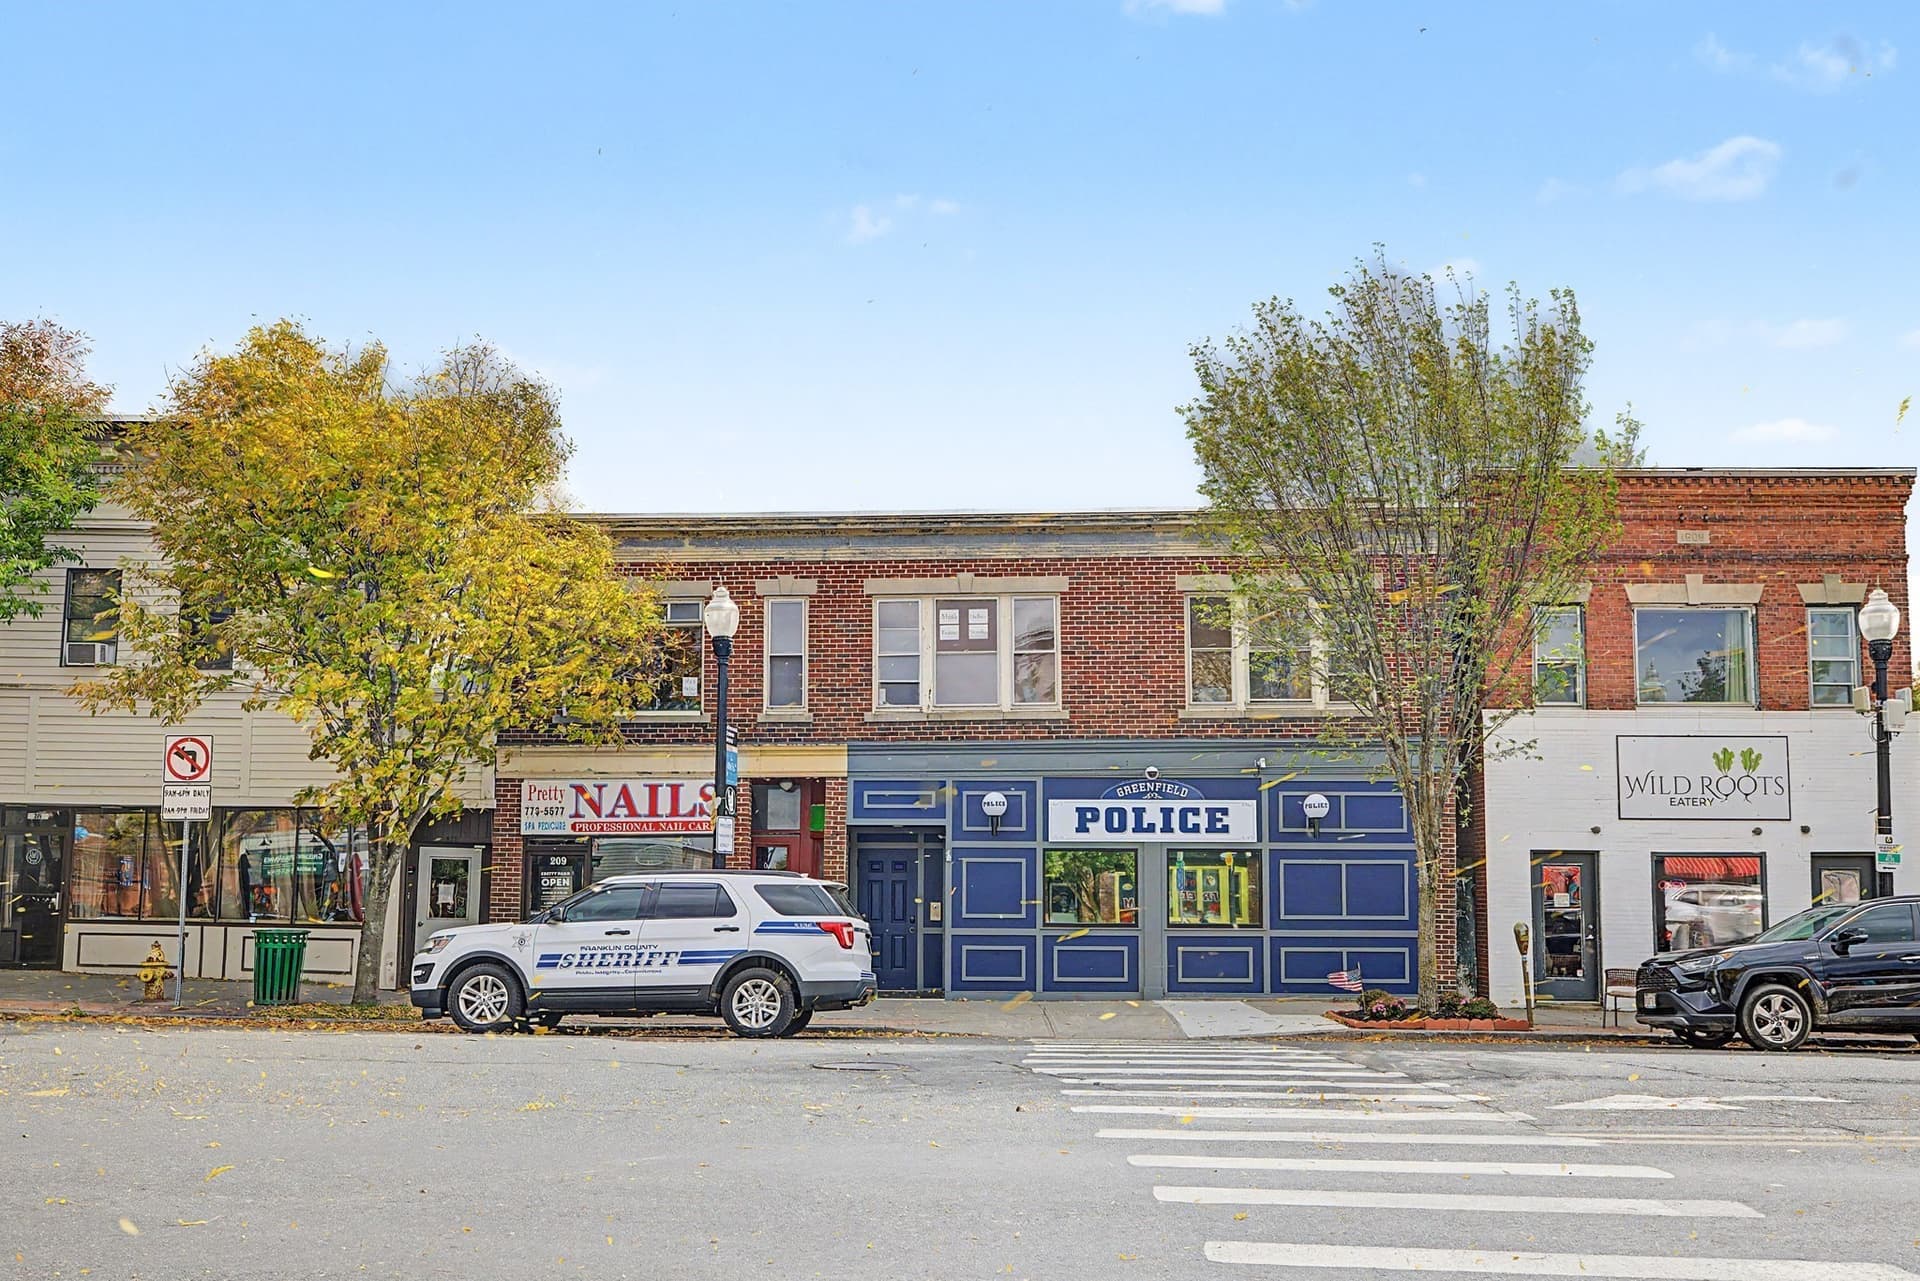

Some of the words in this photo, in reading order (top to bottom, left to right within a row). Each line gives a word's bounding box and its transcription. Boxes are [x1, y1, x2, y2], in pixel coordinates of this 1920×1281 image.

[1116, 782, 1189, 798] GREENFIELD
[1624, 769, 1692, 799] WILD
[1700, 774, 1785, 804] ROOTS
[527, 784, 566, 803] Pretty
[1669, 797, 1715, 807] EATERY
[1075, 806, 1230, 834] POLICE
[524, 821, 536, 831] SPA
[575, 822, 656, 832] PROFESSIONAL
[658, 822, 686, 832] NAIL
[688, 822, 712, 831] CAR
[550, 856, 567, 866] 209
[541, 878, 570, 887] OPEN
[624, 943, 659, 951] COUNTY
[559, 951, 679, 969] SHERIFF
